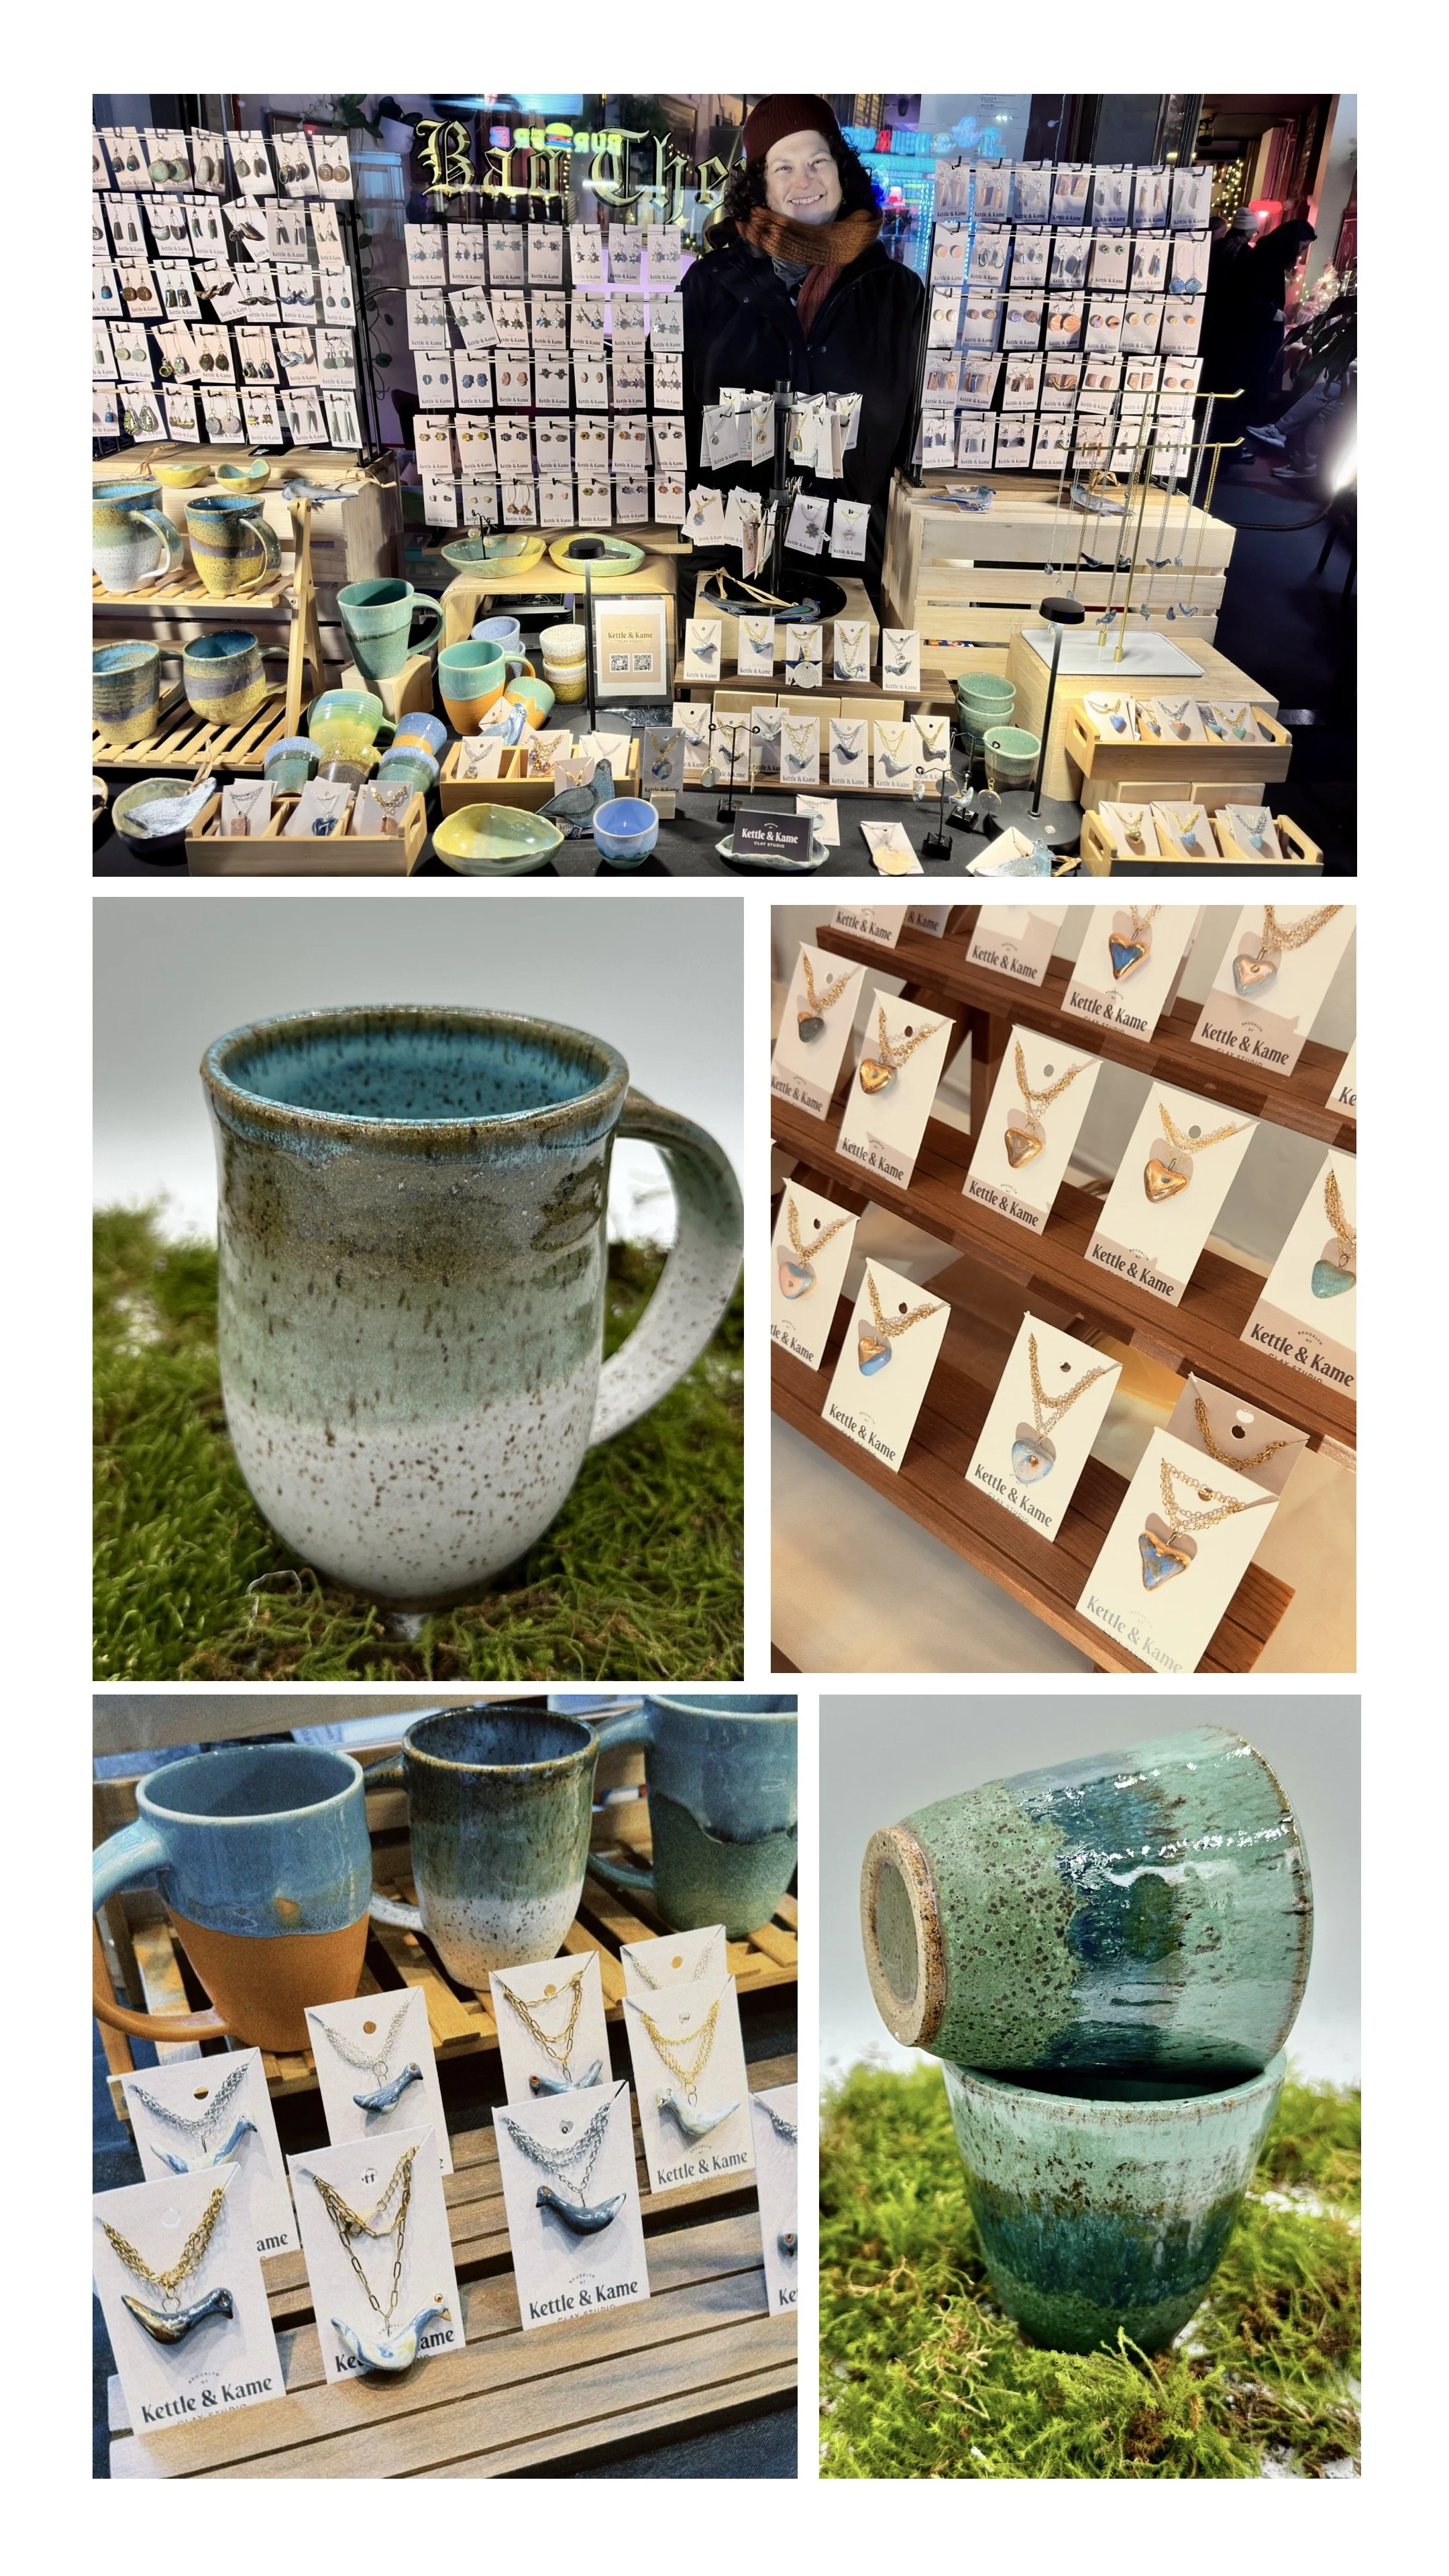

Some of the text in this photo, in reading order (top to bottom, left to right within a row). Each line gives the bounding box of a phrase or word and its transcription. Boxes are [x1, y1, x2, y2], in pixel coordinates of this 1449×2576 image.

[742, 828, 799, 844] Kettle & Kame
[836, 911, 859, 929] Kettle
[860, 920, 867, 932] &
[869, 922, 892, 941] Kame
[908, 911, 939, 931] & Kame
[972, 945, 1000, 965] Kettle
[1000, 956, 1009, 969] &
[1010, 958, 1037, 979] Kame
[1070, 991, 1148, 1031] Kettle & Kame
[1201, 1023, 1289, 1065] Kettle & Kame
[1237, 1054, 1263, 1067] STUDIO
[771, 1076, 823, 1112] Kettle & Kame
[842, 1137, 904, 1180] Kettle & Kame
[969, 1181, 1039, 1227] Kettle & Kame
[1092, 1244, 1174, 1296] Kettle & Kame
[782, 1332, 790, 1345] &
[790, 1337, 814, 1362] Kame
[1250, 1323, 1354, 1387] Kettle & Kame
[1298, 1331, 1323, 1345] BROOKLYN
[829, 1403, 857, 1432] Kettle
[858, 1425, 867, 1440] &
[868, 1431, 896, 1461] Kame
[975, 1464, 1052, 1527] Kettle & Kame
[1087, 1596, 1126, 1634] Kettle
[1127, 1627, 1140, 1645] &
[1142, 1637, 1182, 1673] Kame
[658, 2151, 748, 2185] Kettle & Kame
[256, 2233, 288, 2252] ame
[529, 2280, 638, 2319] Kettle & Kame
[418, 2329, 454, 2351] ame
[142, 2396, 196, 2423] Kettle
[202, 2390, 218, 2408] &
[222, 2377, 273, 2402] Kame
